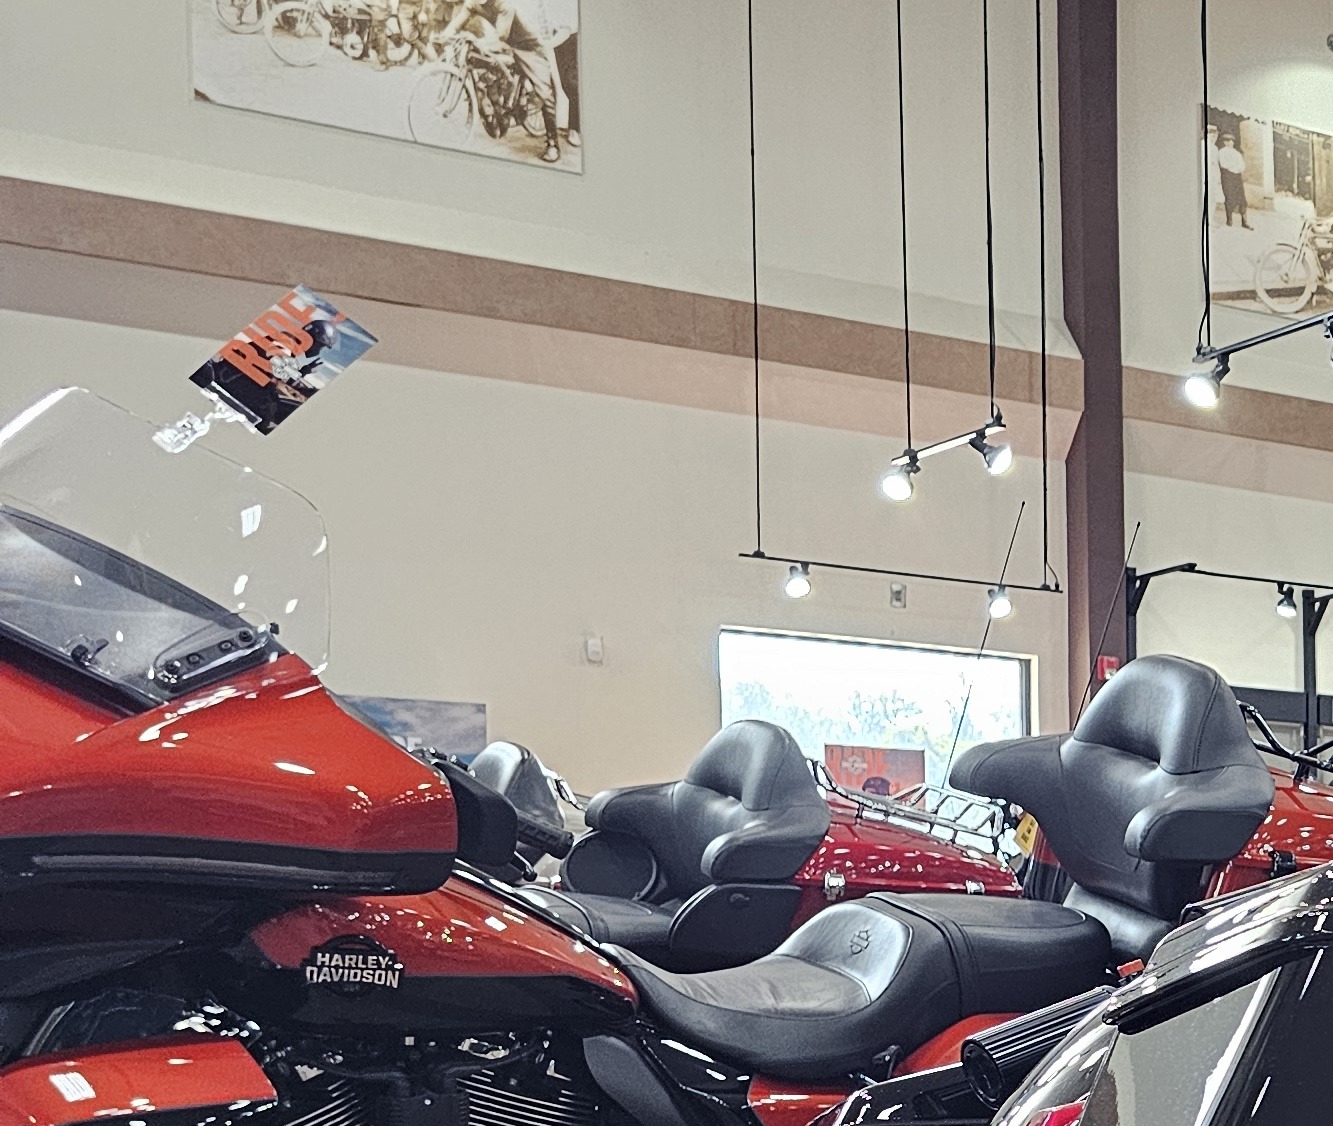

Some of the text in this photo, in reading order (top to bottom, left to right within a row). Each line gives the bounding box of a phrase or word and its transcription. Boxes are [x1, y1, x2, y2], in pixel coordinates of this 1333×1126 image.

[217, 290, 318, 388] RIDE
[316, 952, 393, 969] HARLEY-
[305, 965, 400, 989] DAVIDSON
